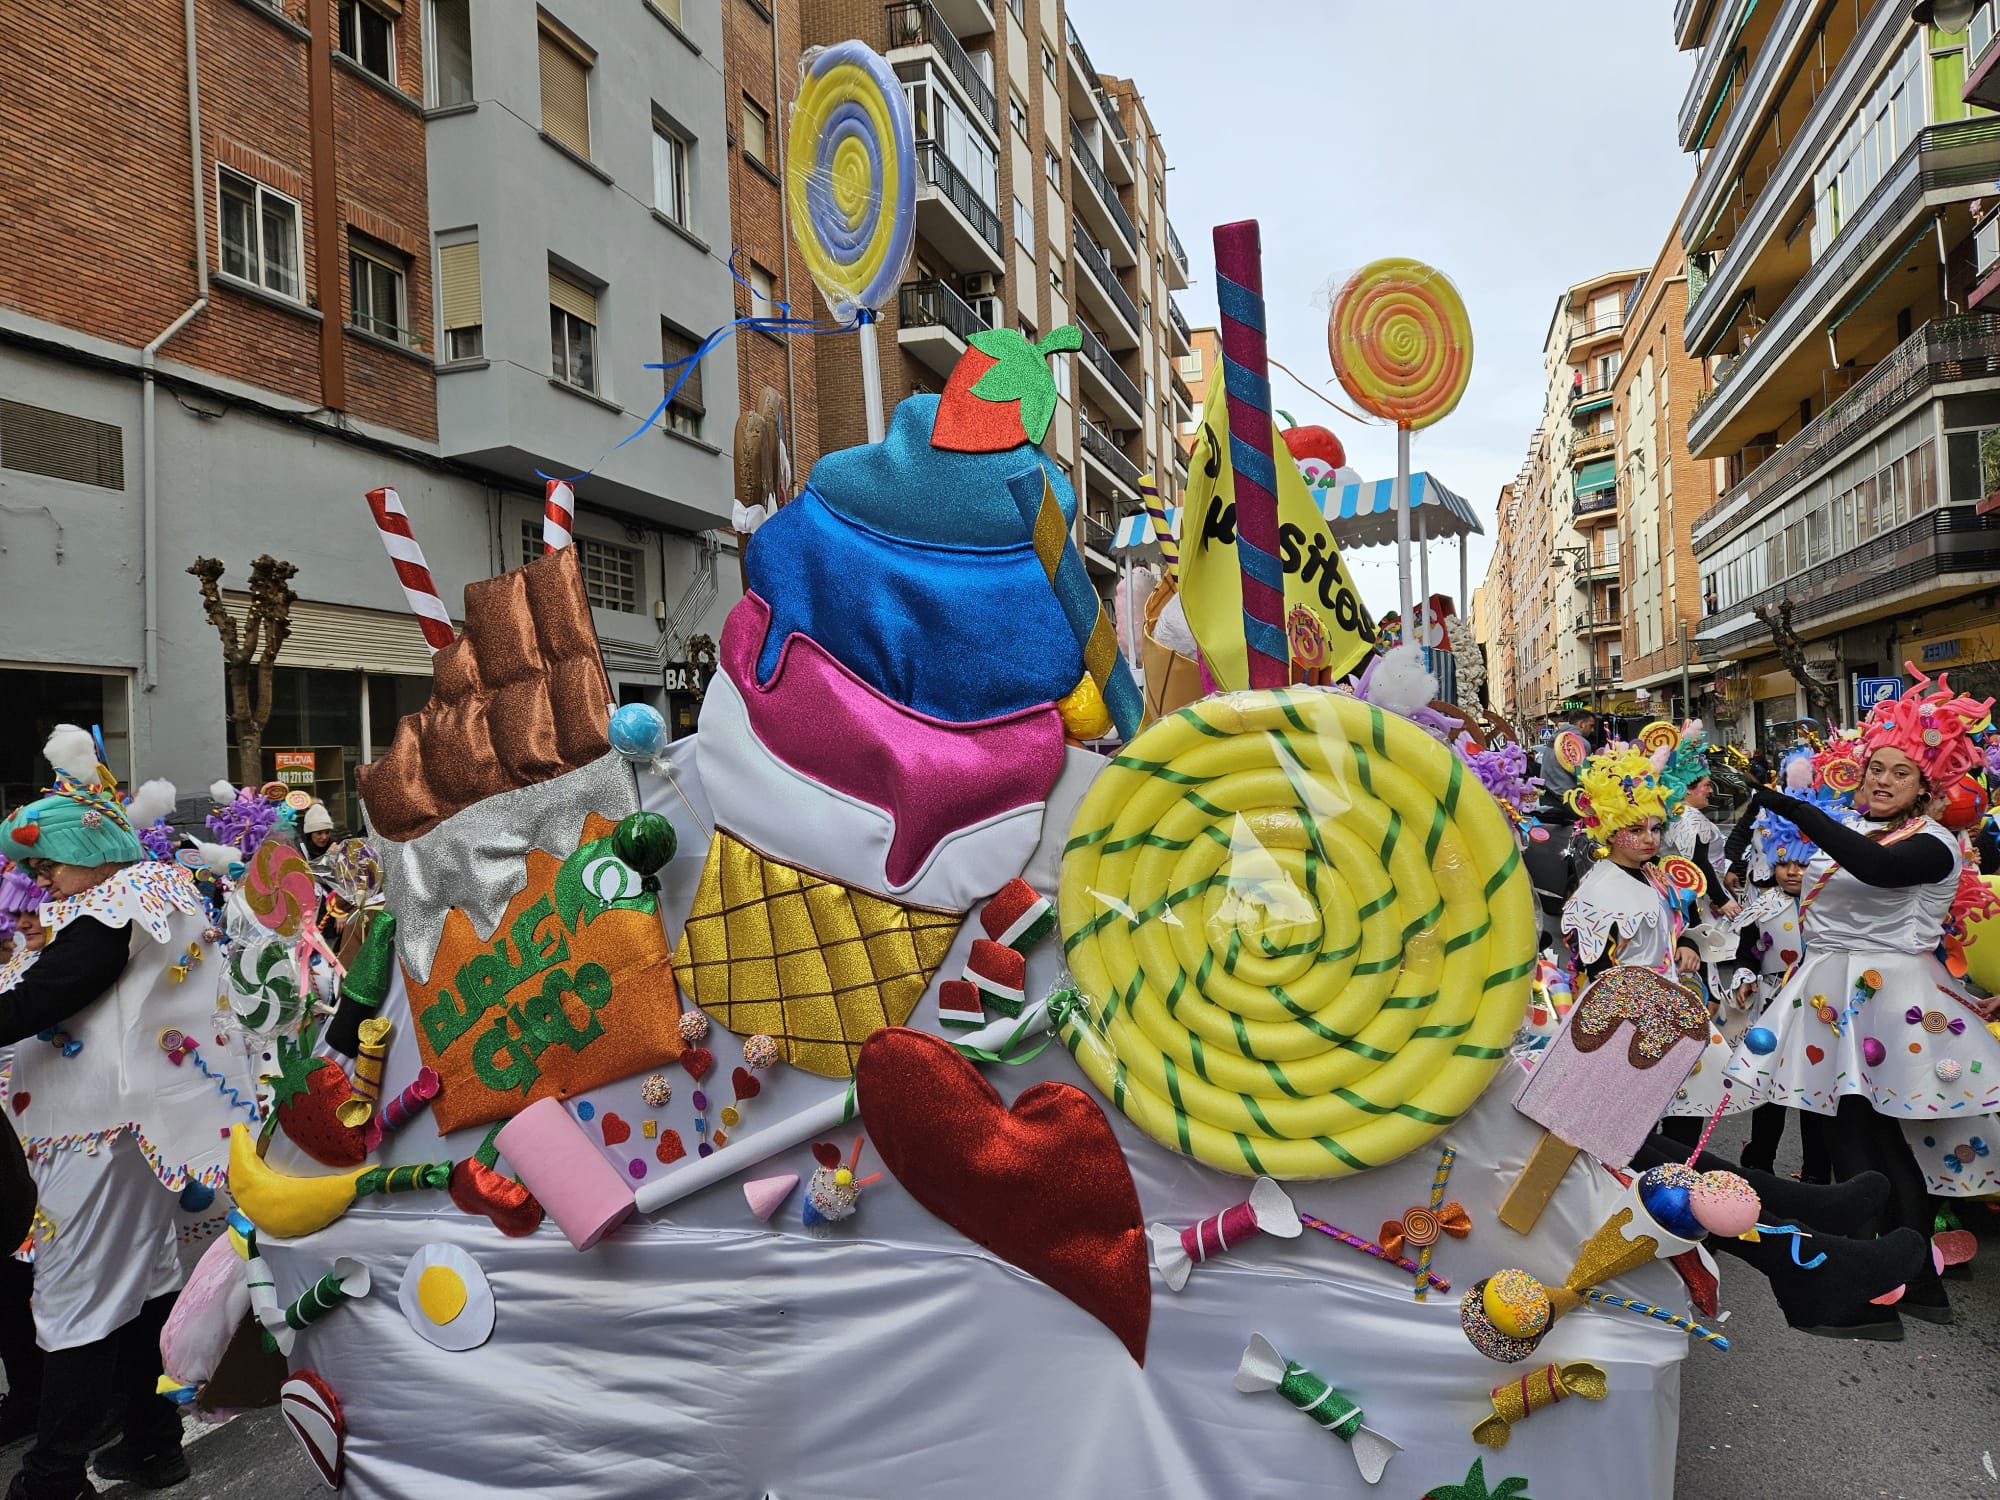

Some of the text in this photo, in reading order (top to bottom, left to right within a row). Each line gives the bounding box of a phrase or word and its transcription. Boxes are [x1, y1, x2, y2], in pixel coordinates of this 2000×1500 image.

[1921, 639, 1960, 662] ZEEMAN
[665, 668, 700, 690] BAR
[278, 755, 312, 765] FELOVA
[472, 962, 612, 1097] CHOCO
